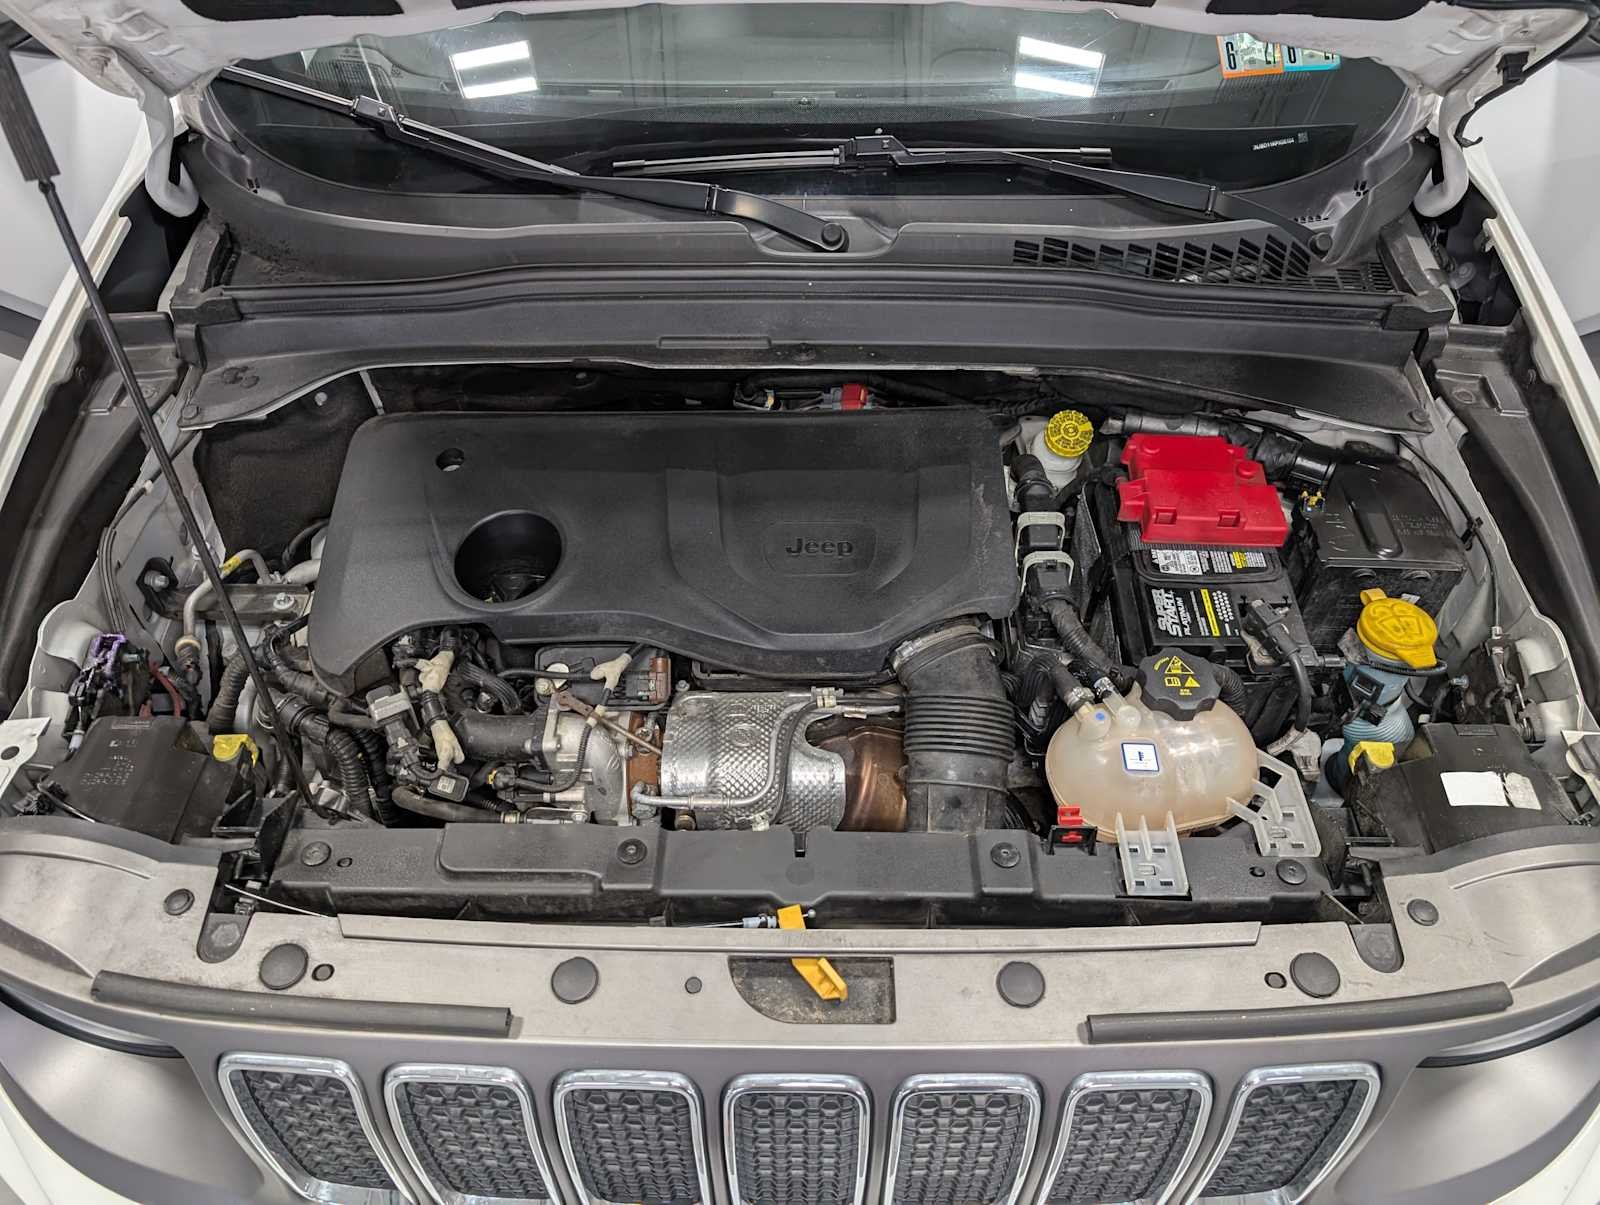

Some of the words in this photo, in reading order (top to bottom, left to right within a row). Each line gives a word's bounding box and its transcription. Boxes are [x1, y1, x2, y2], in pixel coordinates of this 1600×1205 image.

[1225, 41, 1237, 70] 6
[785, 538, 854, 560] Jeep
[1151, 588, 1167, 631] SUPER
[1175, 597, 1192, 636] PLATINUM
